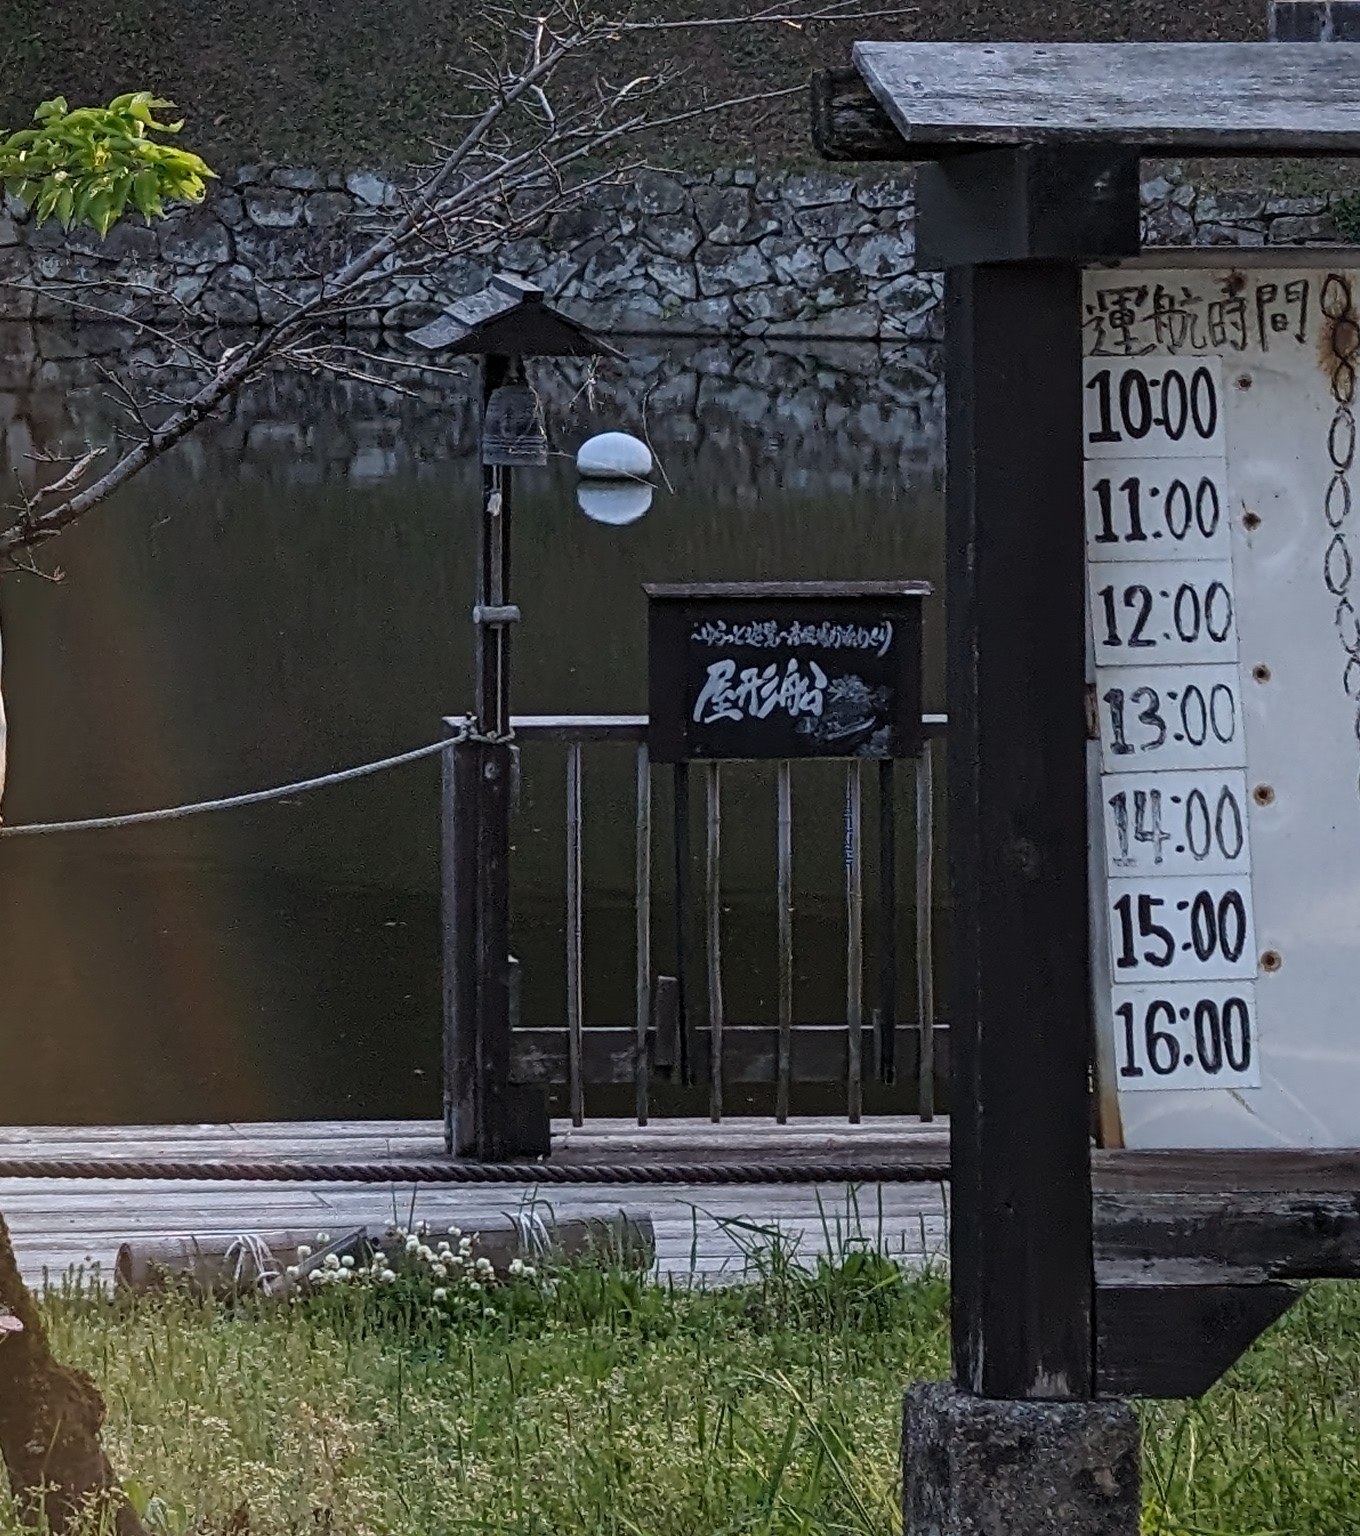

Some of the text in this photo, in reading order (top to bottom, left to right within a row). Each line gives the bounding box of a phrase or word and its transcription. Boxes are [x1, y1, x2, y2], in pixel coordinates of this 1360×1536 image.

[1083, 279, 1309, 356] 運航時間
[1085, 366, 1218, 443] 10:00
[1091, 476, 1220, 544] 11:00
[1097, 579, 1233, 648] 12:00
[693, 658, 828, 724] 屋形船
[1102, 683, 1237, 756] 13:00
[1108, 784, 1244, 867] 14:00
[1112, 889, 1248, 969] 15:00
[1115, 996, 1252, 1078] 16:00
